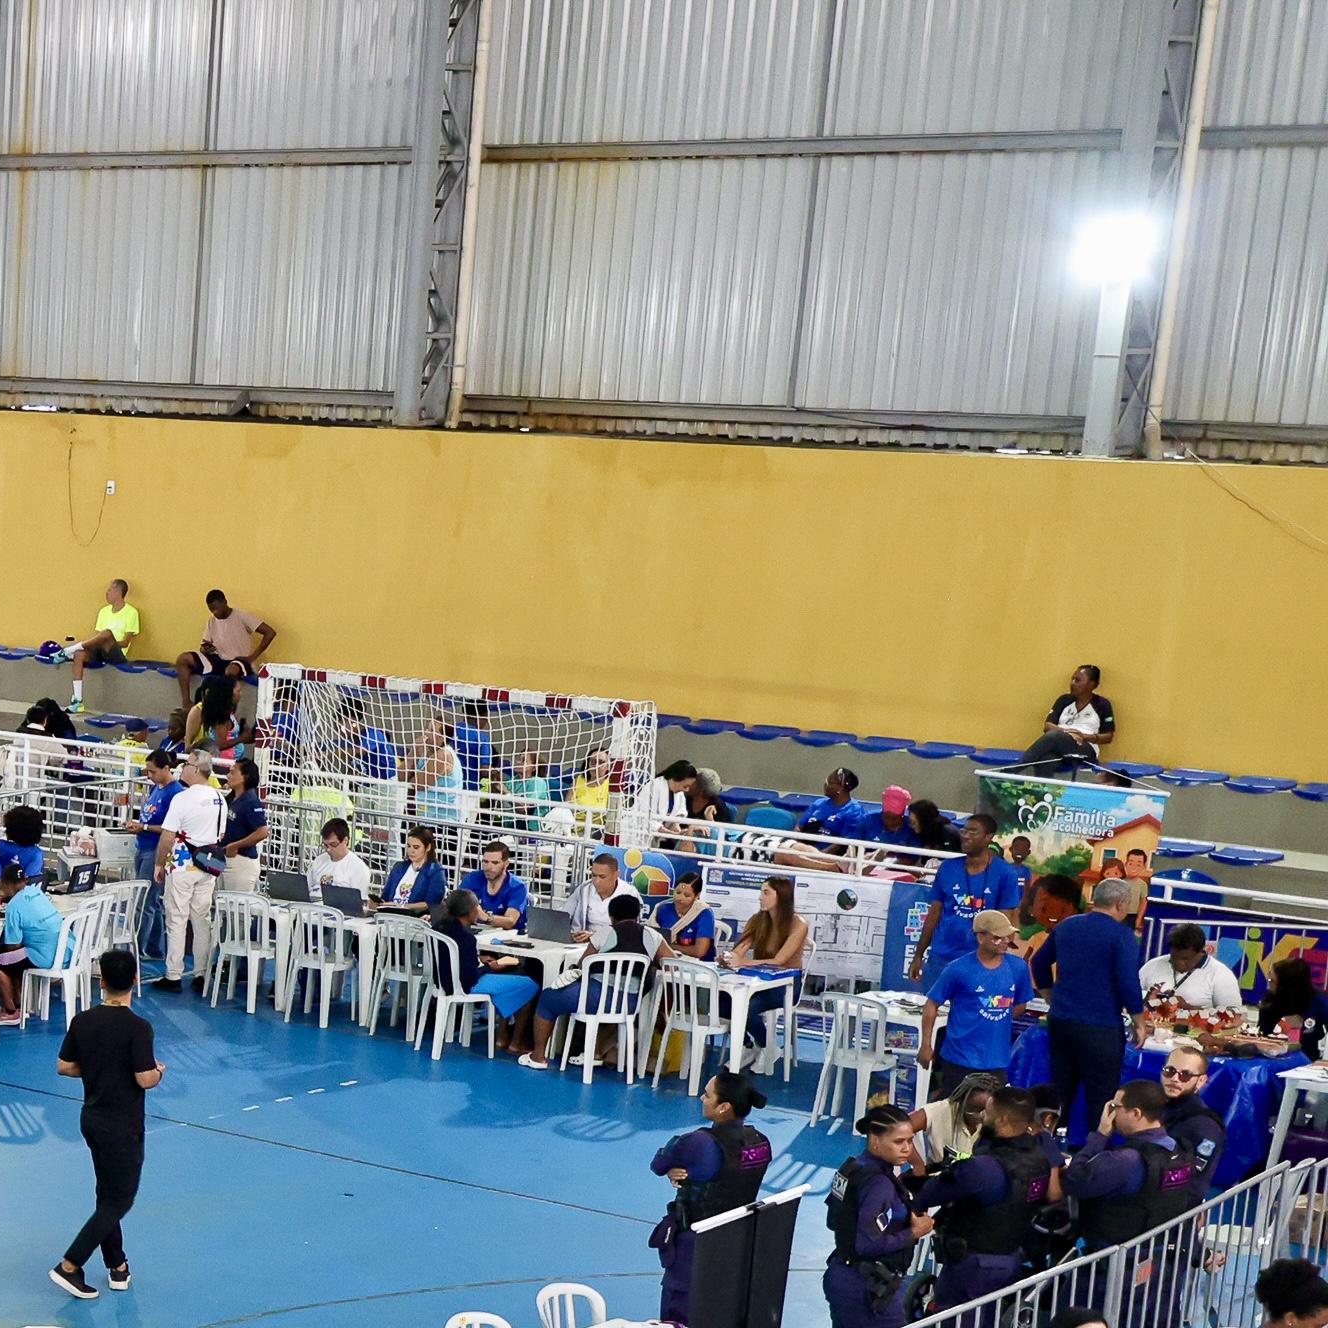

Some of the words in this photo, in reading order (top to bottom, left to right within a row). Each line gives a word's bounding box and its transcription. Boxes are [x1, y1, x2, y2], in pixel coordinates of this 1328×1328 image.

[1053, 806, 1116, 828] Família
[1053, 822, 1114, 838] acolhedora
[77, 871, 92, 884] 15
